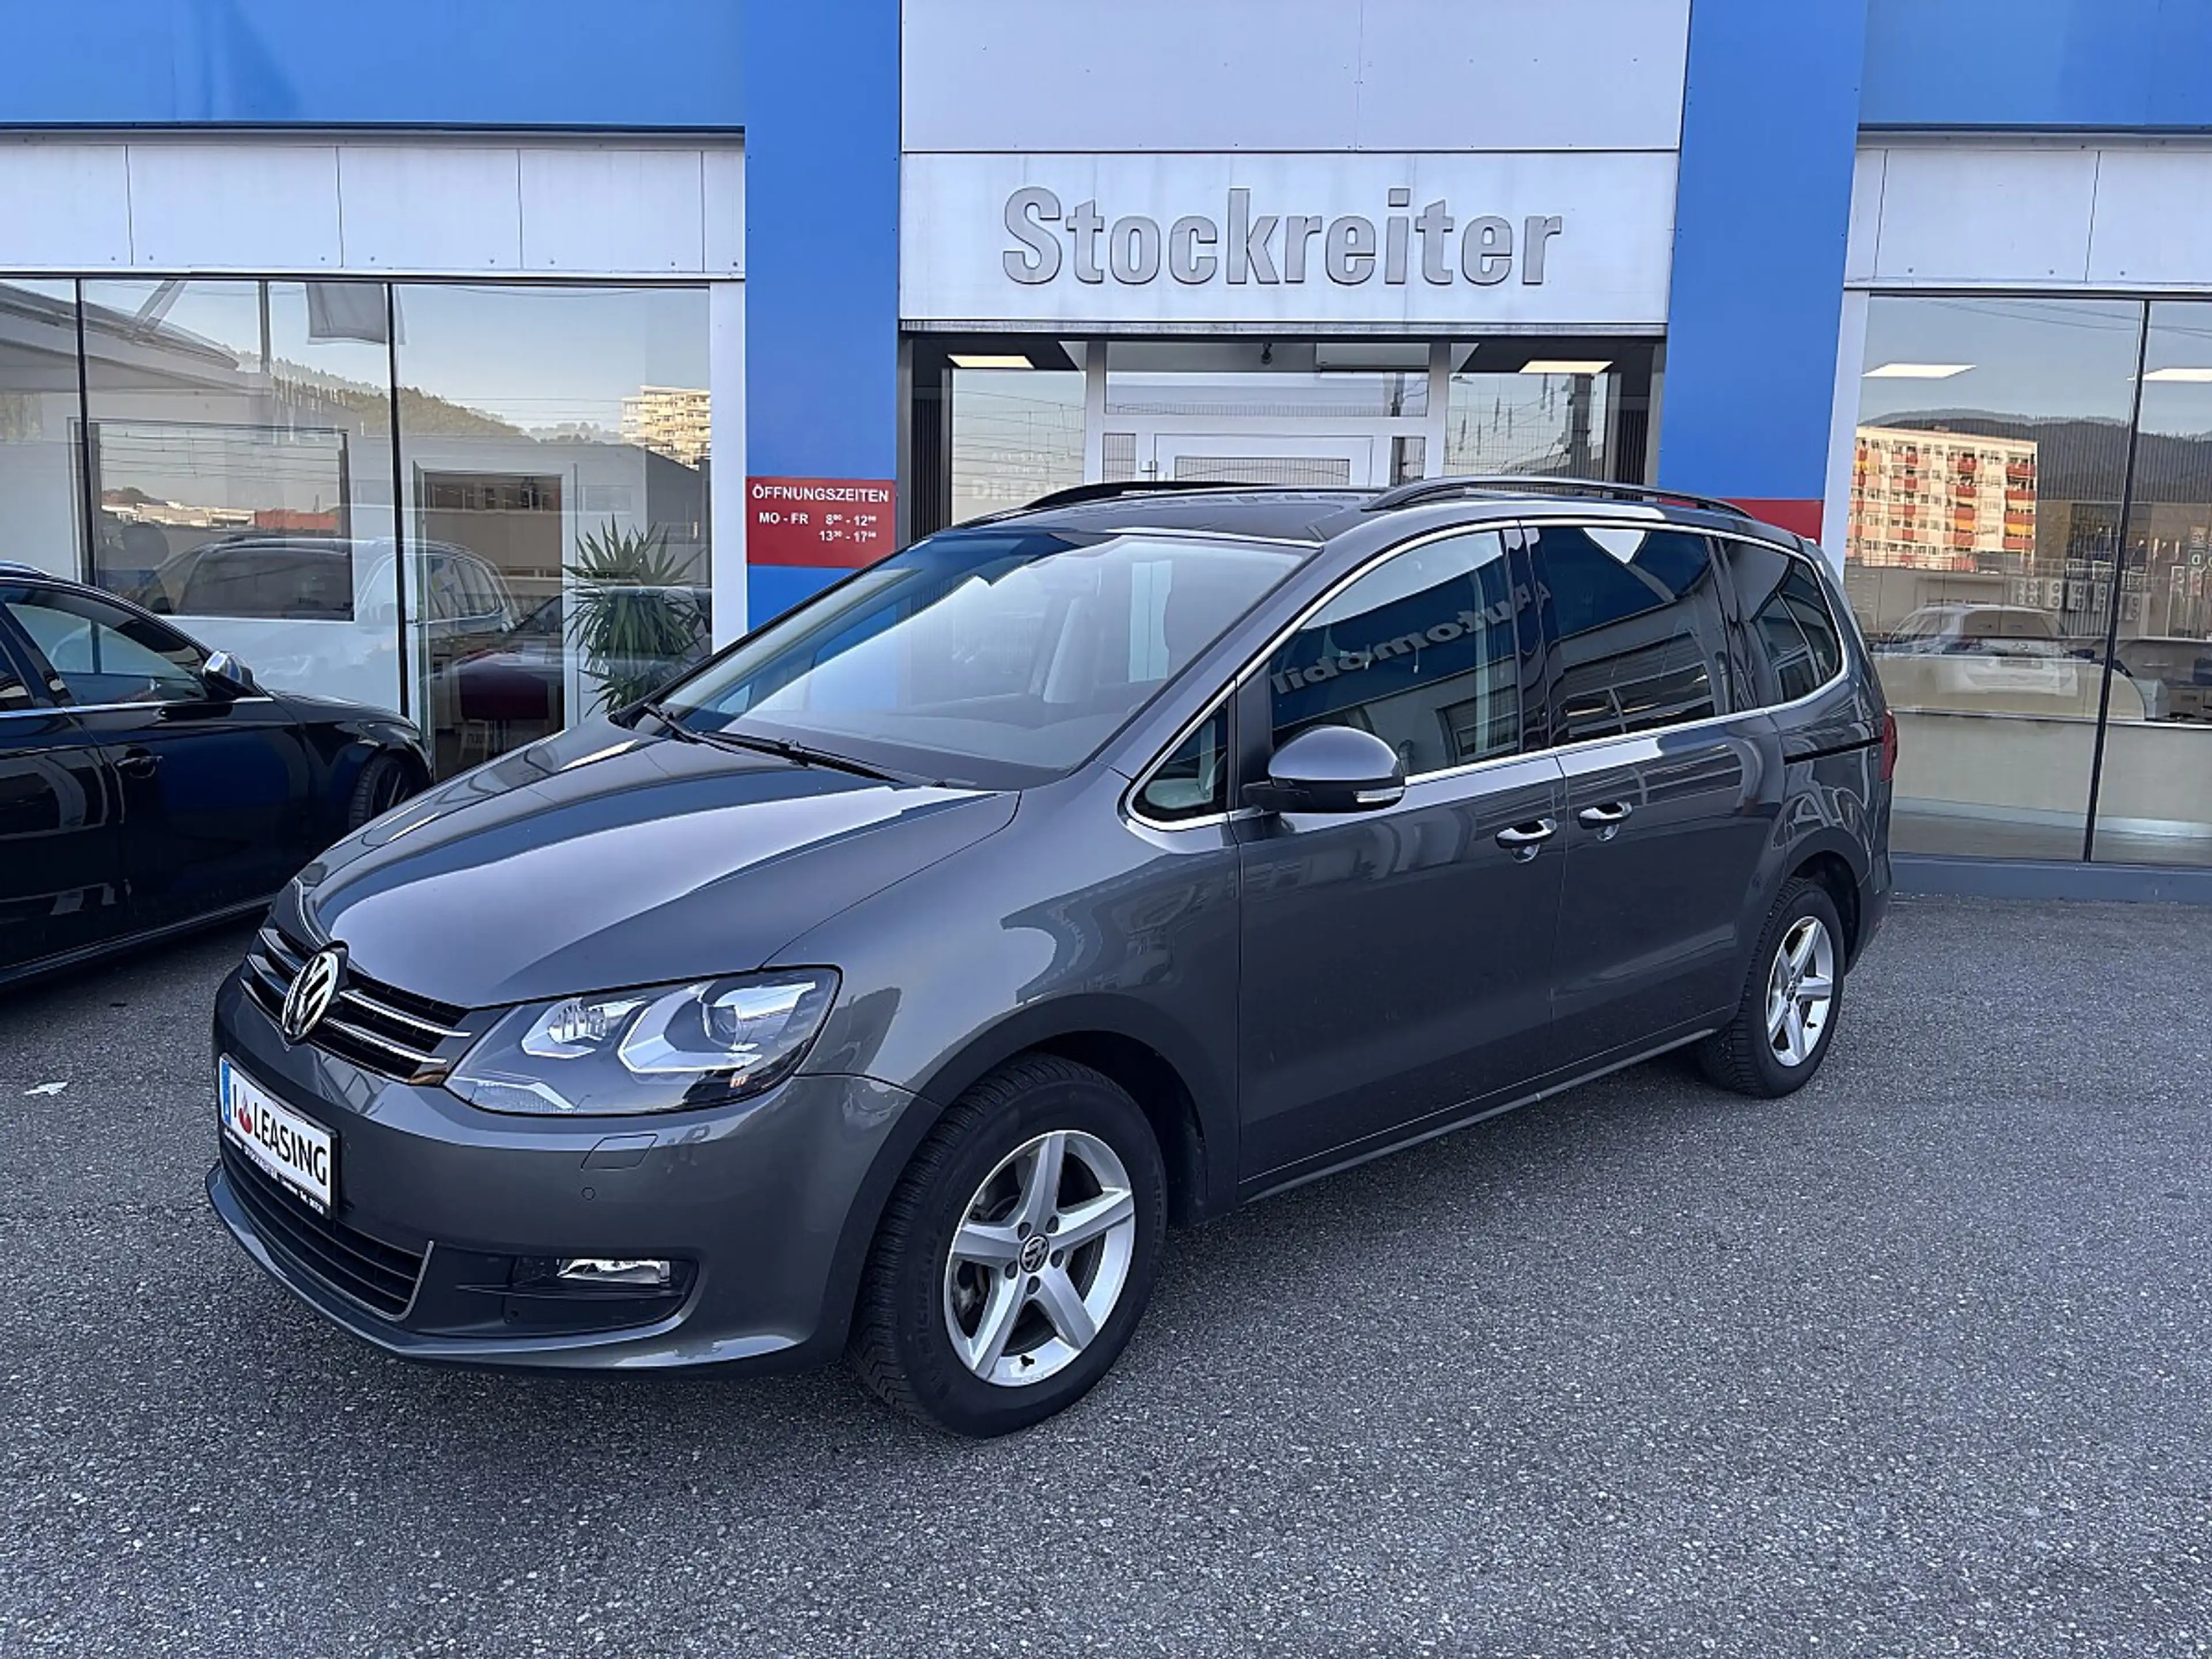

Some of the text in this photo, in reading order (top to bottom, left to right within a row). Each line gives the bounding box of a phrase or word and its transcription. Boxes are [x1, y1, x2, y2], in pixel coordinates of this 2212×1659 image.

[1002, 185, 1562, 286] Stockreiter
[752, 483, 889, 503] ÖFFNUNGSZEITEN
[758, 512, 780, 524] MO
[791, 513, 809, 525] FR
[253, 1102, 327, 1187] LEASING
